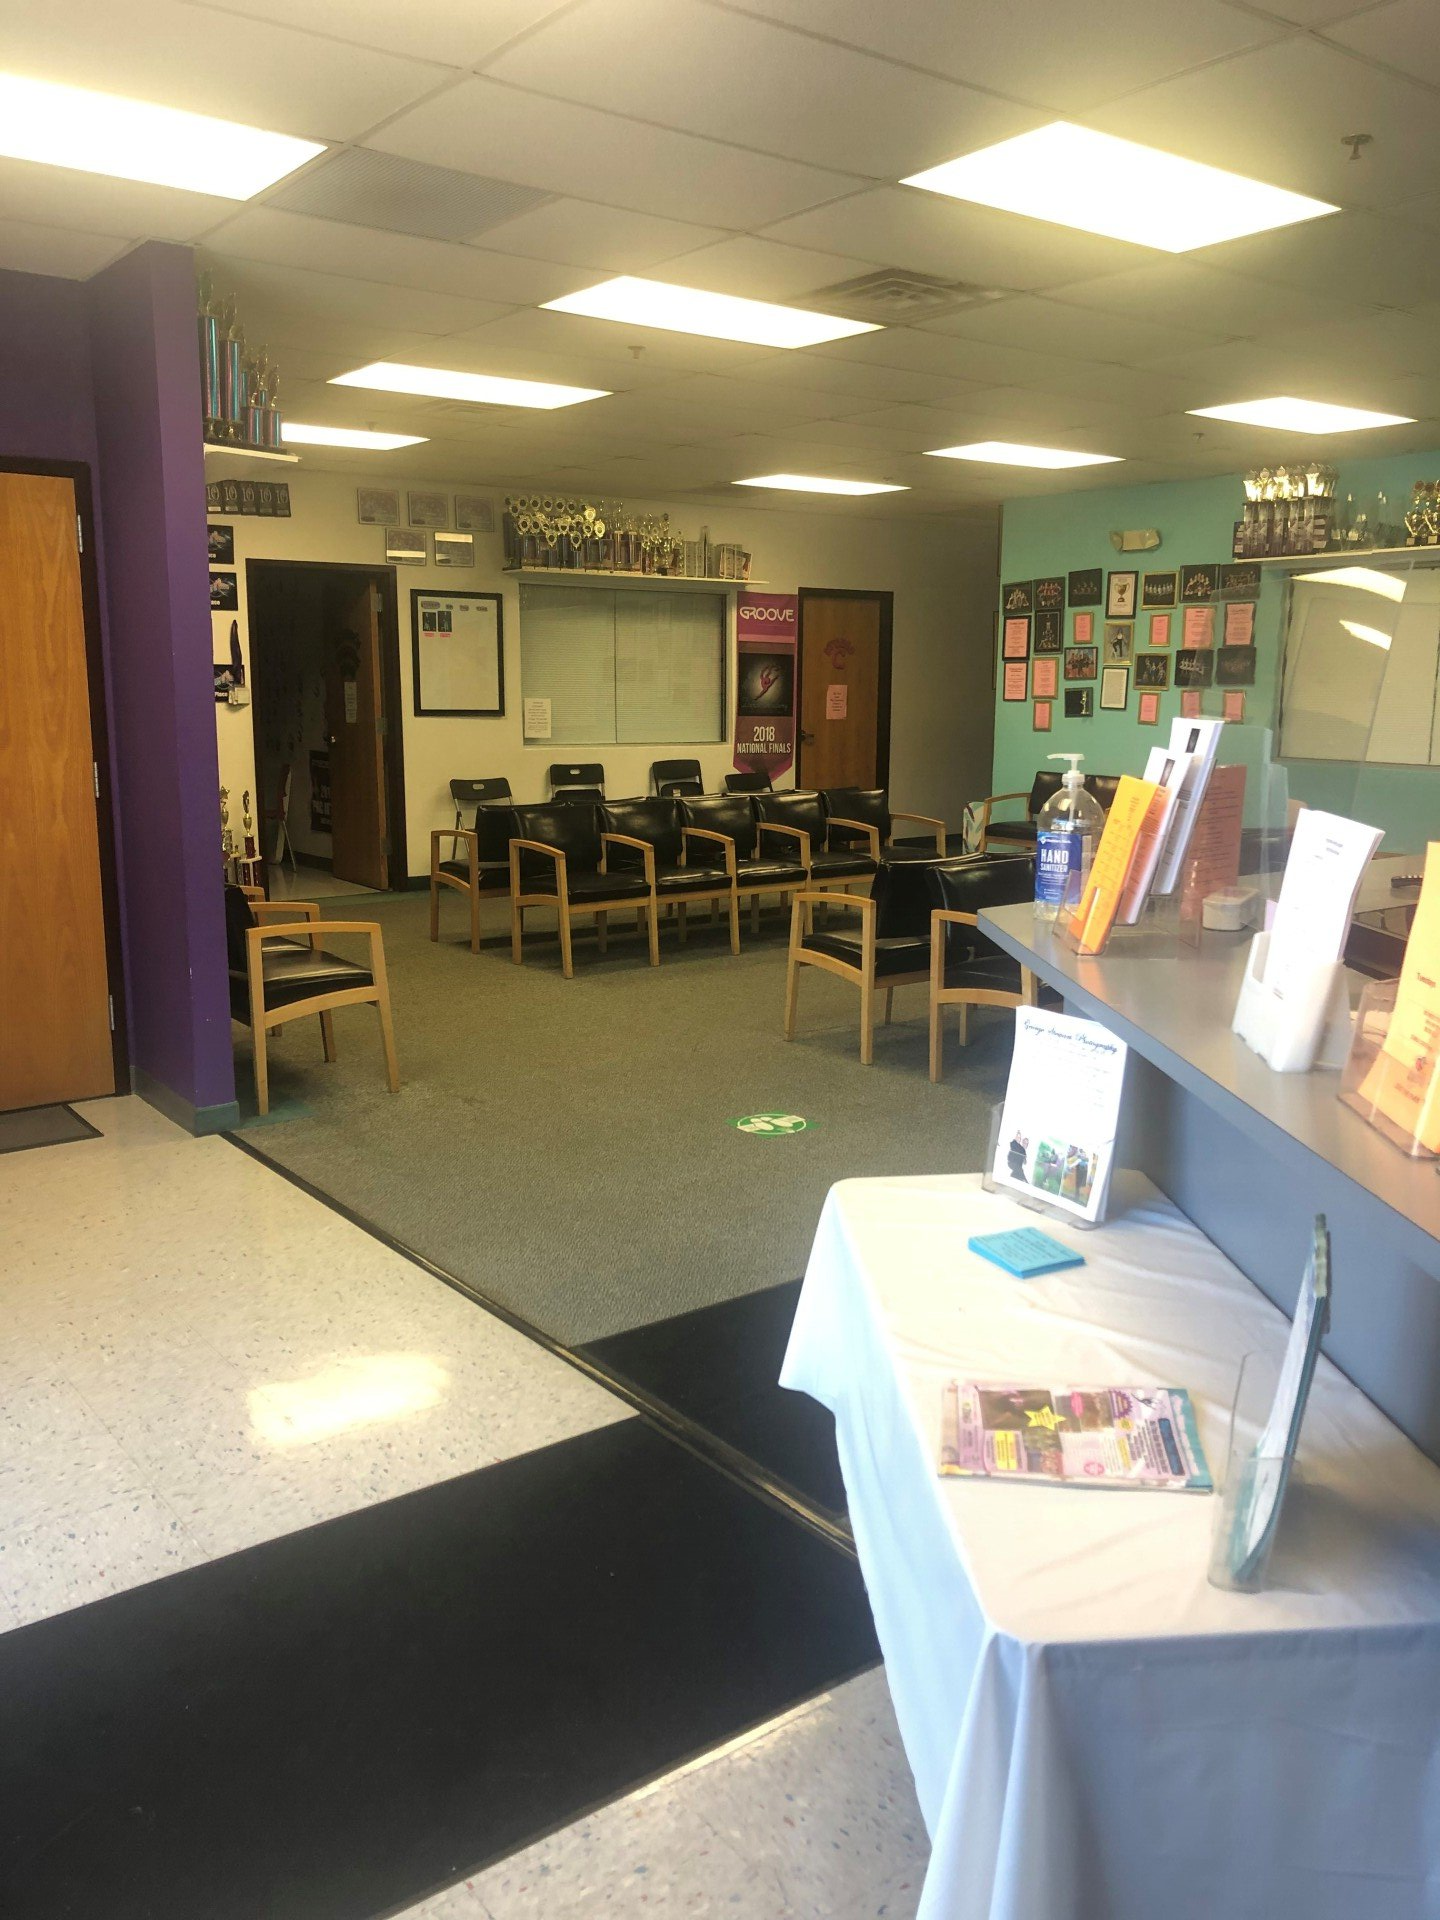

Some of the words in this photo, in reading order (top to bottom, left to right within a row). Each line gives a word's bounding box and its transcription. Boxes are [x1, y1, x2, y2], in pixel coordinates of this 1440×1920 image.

[225, 485, 238, 501] 10
[739, 606, 795, 622] GROOVE
[753, 726, 776, 742] 2018
[736, 742, 768, 754] NATIONAL
[768, 742, 792, 754] FINALS
[1040, 848, 1070, 864] HAND
[1040, 862, 1069, 873] SANITIZER
